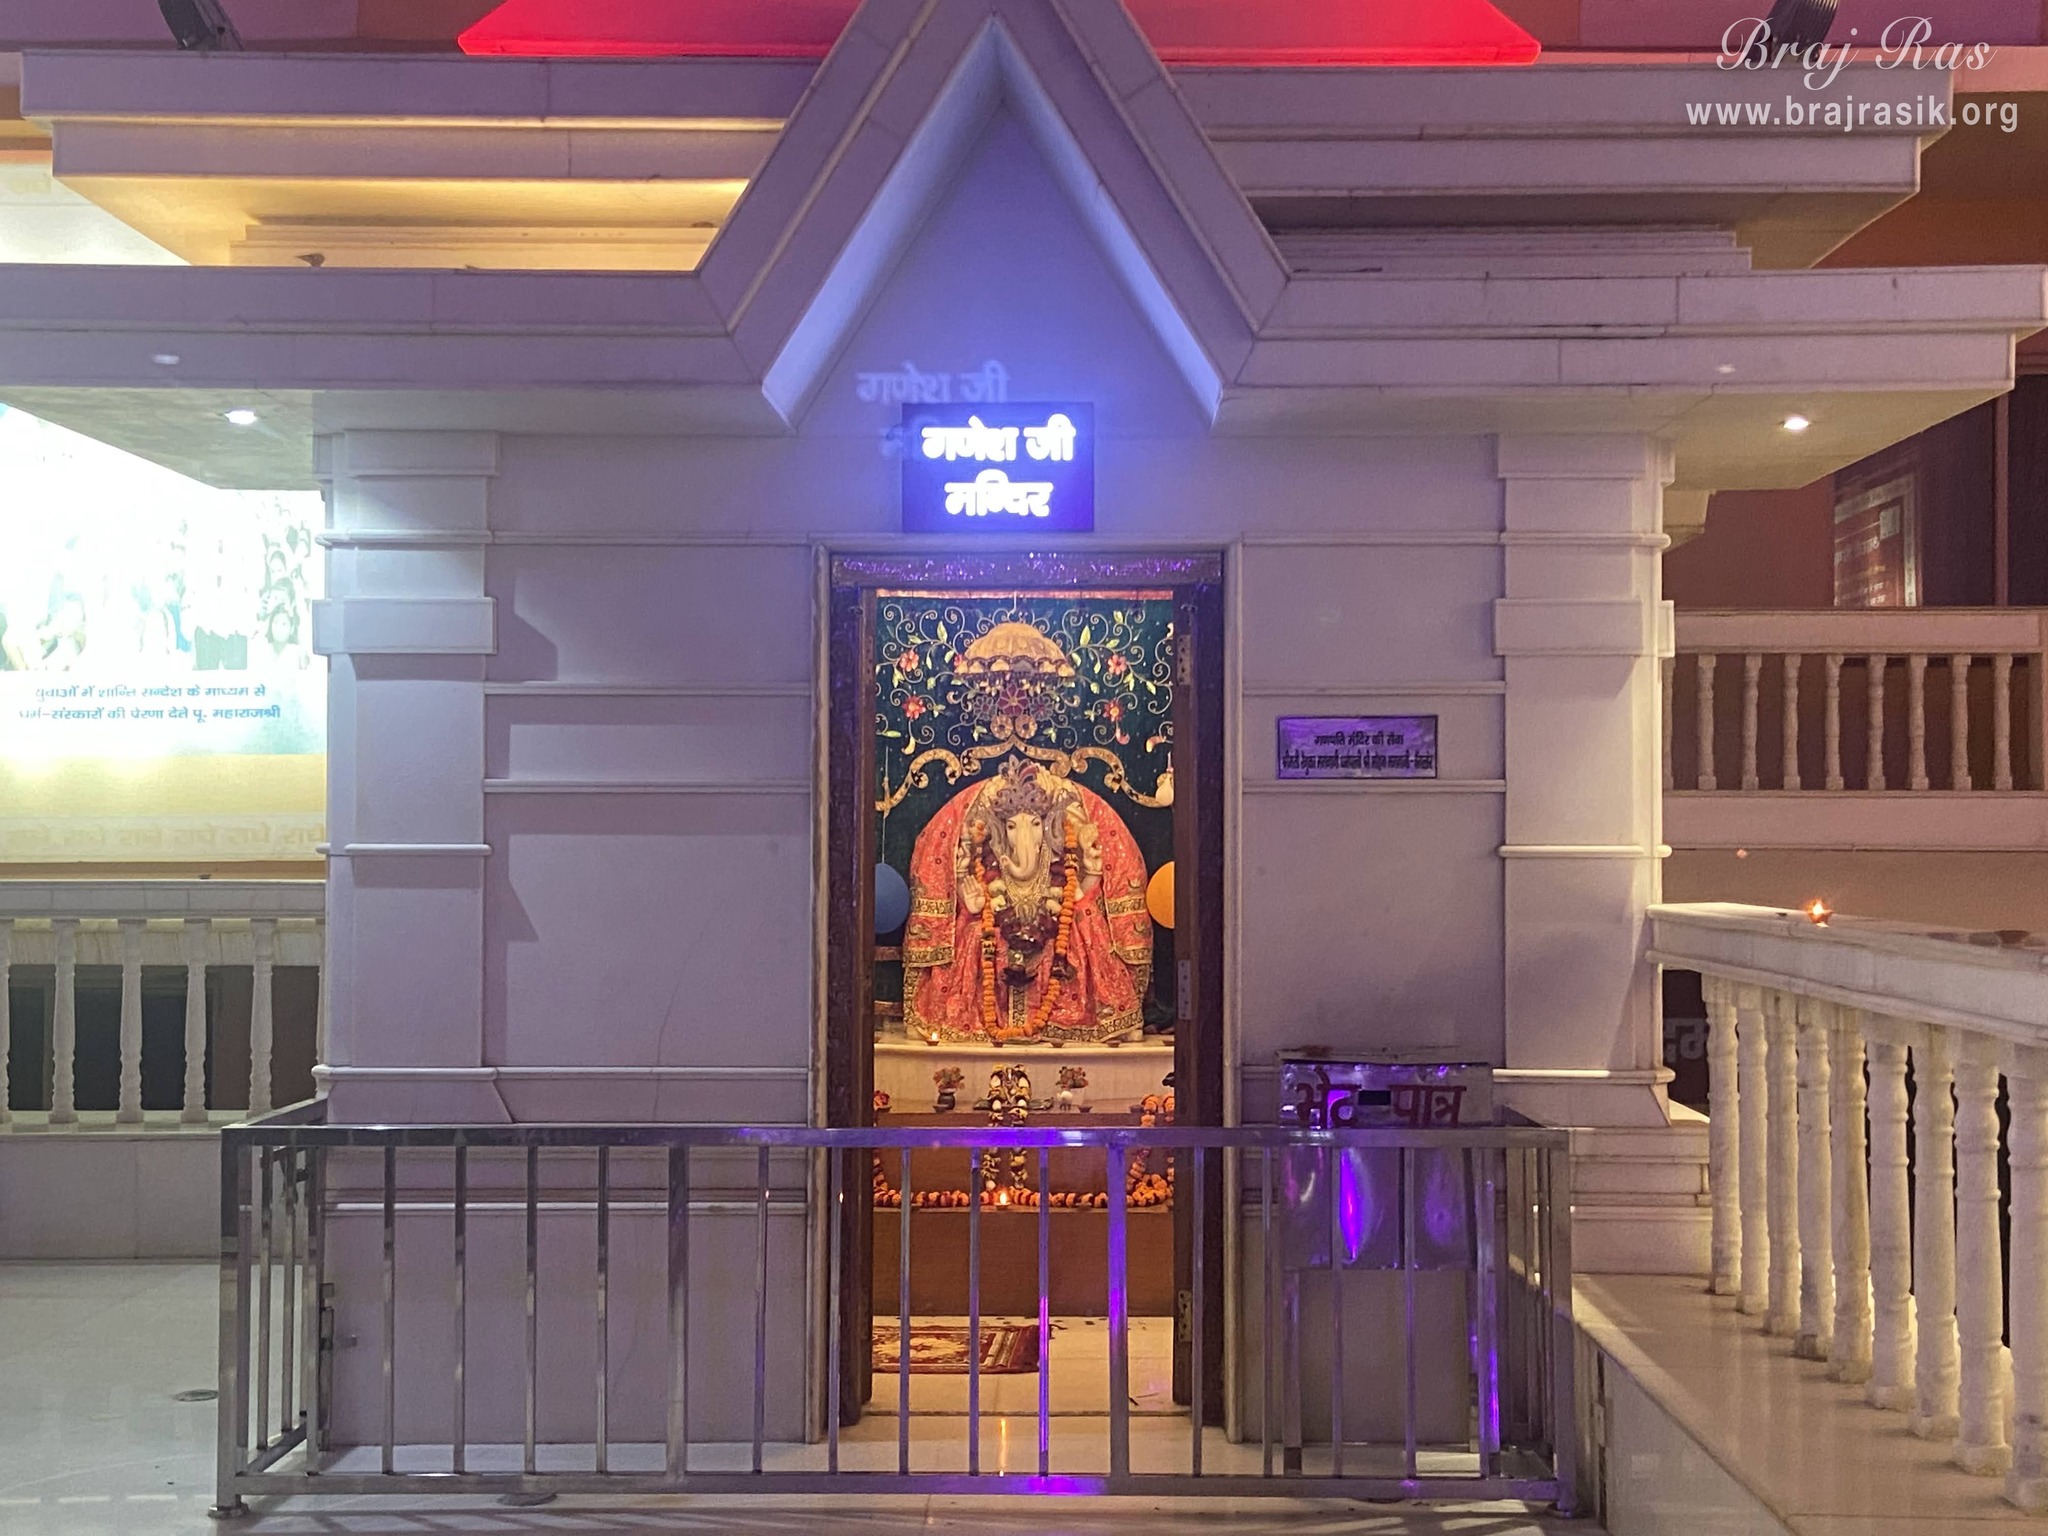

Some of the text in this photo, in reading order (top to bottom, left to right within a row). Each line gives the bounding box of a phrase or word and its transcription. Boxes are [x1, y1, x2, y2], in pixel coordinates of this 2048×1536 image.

[921, 415, 1020, 462] गणेश
[1023, 413, 1077, 461] जी
[81, 684, 95, 698] में
[187, 684, 201, 697] के
[254, 683, 266, 697] से
[107, 706, 126, 720] की
[168, 706, 188, 719] देते
[212, 704, 281, 719] महाराजश्री
